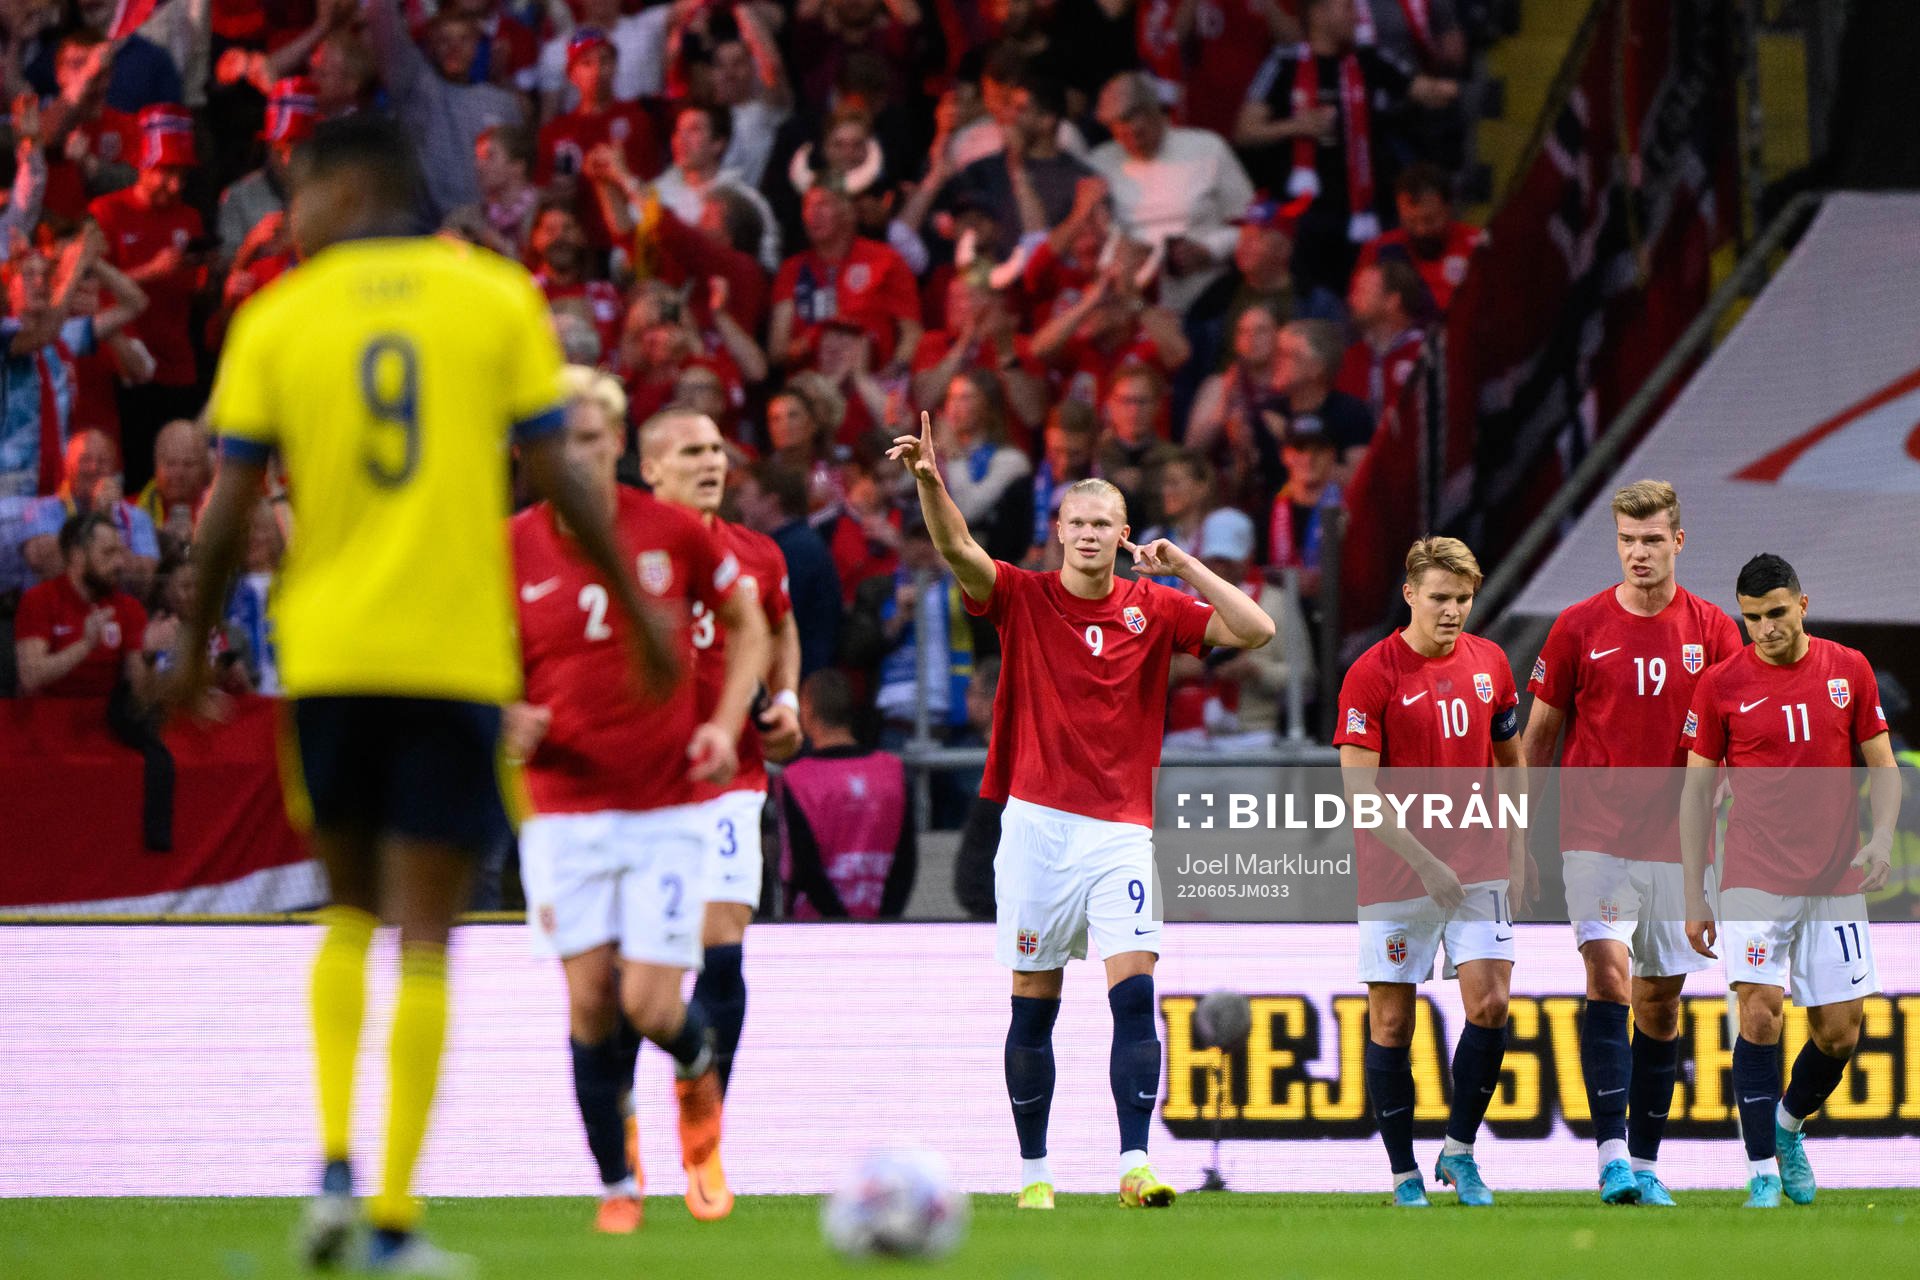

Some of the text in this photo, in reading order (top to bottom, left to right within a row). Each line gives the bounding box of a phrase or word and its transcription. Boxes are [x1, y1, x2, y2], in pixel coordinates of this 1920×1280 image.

[361, 333, 421, 488] 9
[577, 583, 612, 641] 2
[692, 600, 715, 649] 3
[1085, 625, 1104, 657] 9
[1633, 657, 1667, 696] 19
[1437, 698, 1469, 739] 10
[1781, 703, 1811, 743] 11
[717, 818, 738, 858] 3
[659, 874, 684, 920] 2
[1127, 879, 1145, 914] 9
[1834, 922, 1862, 963] 11
